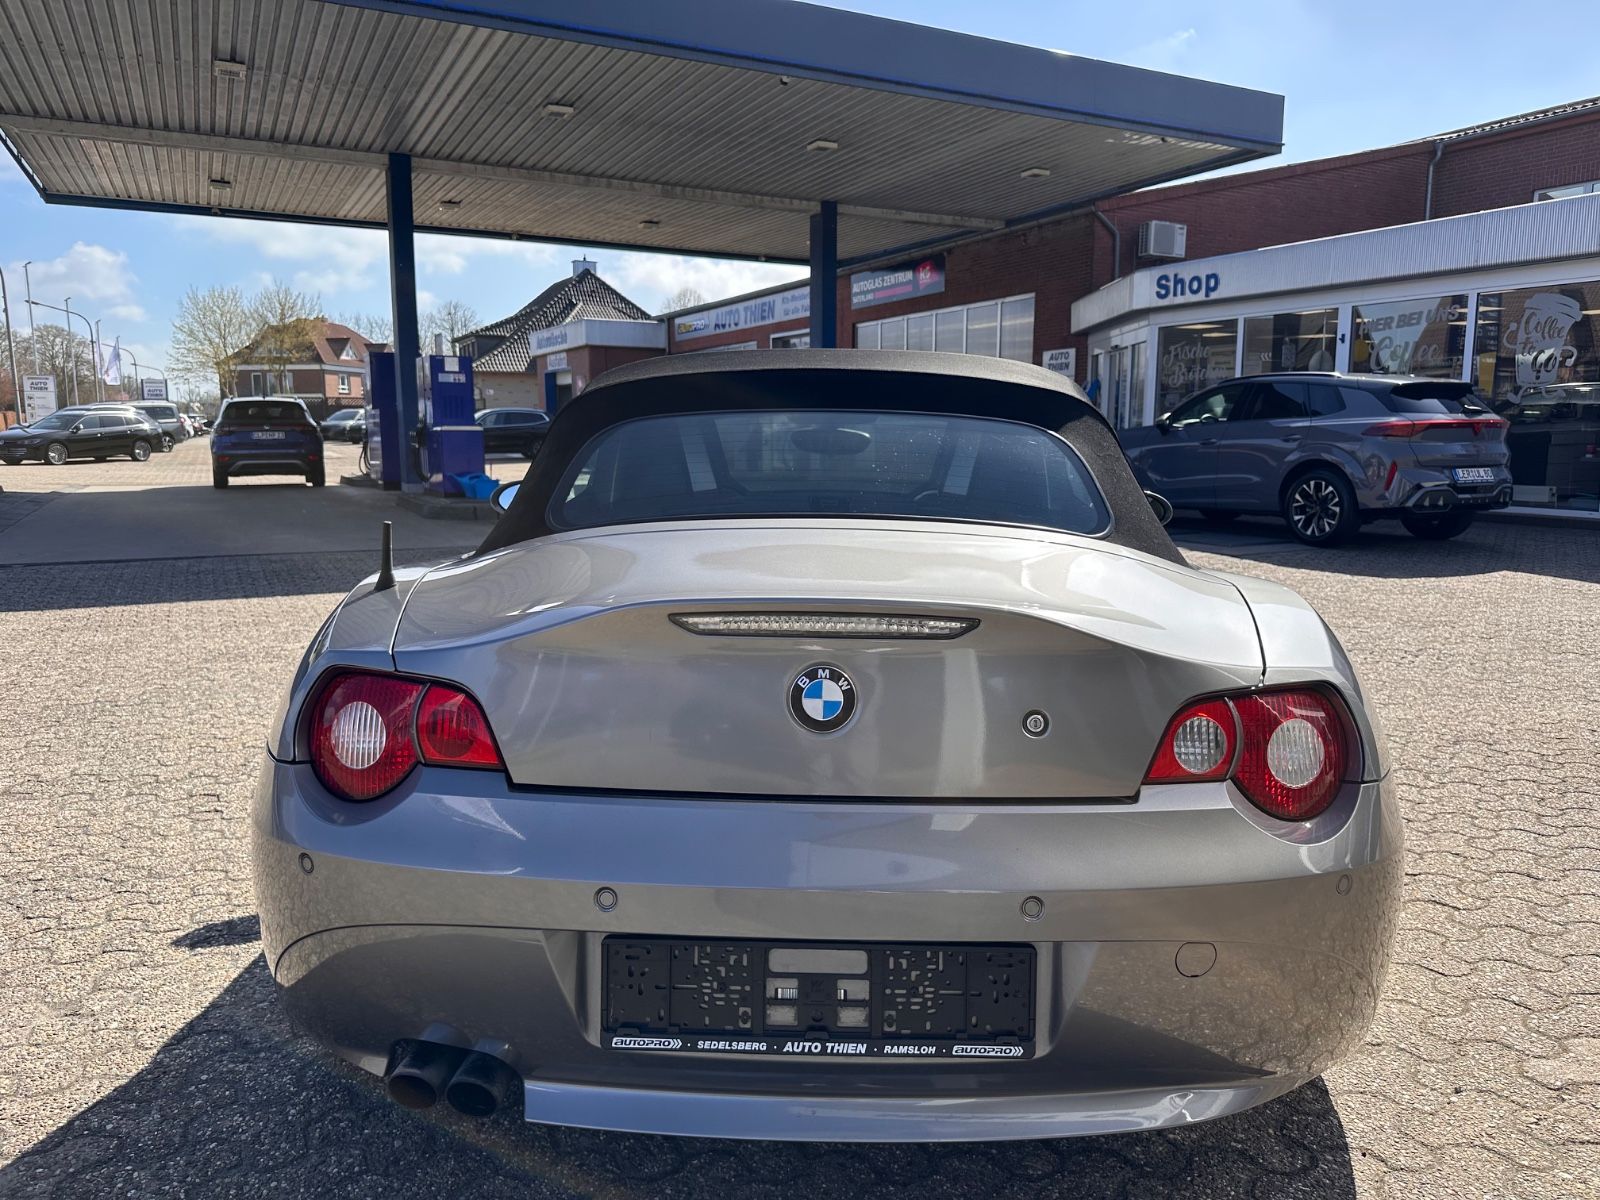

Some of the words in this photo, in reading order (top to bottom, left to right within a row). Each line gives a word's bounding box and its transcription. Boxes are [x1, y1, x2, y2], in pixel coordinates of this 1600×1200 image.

[852, 278, 882, 292] AUTOGLAS
[883, 269, 913, 287] ZENTRUM
[1155, 272, 1220, 300] Shop
[714, 308, 740, 331] AUTO
[743, 299, 775, 325] THIEN
[1395, 310, 1425, 329] BEI
[1425, 304, 1460, 323] UNS
[1524, 311, 1566, 340] Coffee
[1047, 361, 1070, 371] THIEN
[1048, 351, 1070, 361] AUTO
[797, 668, 851, 691] BMW
[697, 1040, 767, 1051] SEDELSBERG
[783, 1041, 821, 1053] AUTO
[825, 1042, 867, 1054] THIEN
[883, 1045, 936, 1055] RAMSLOH
